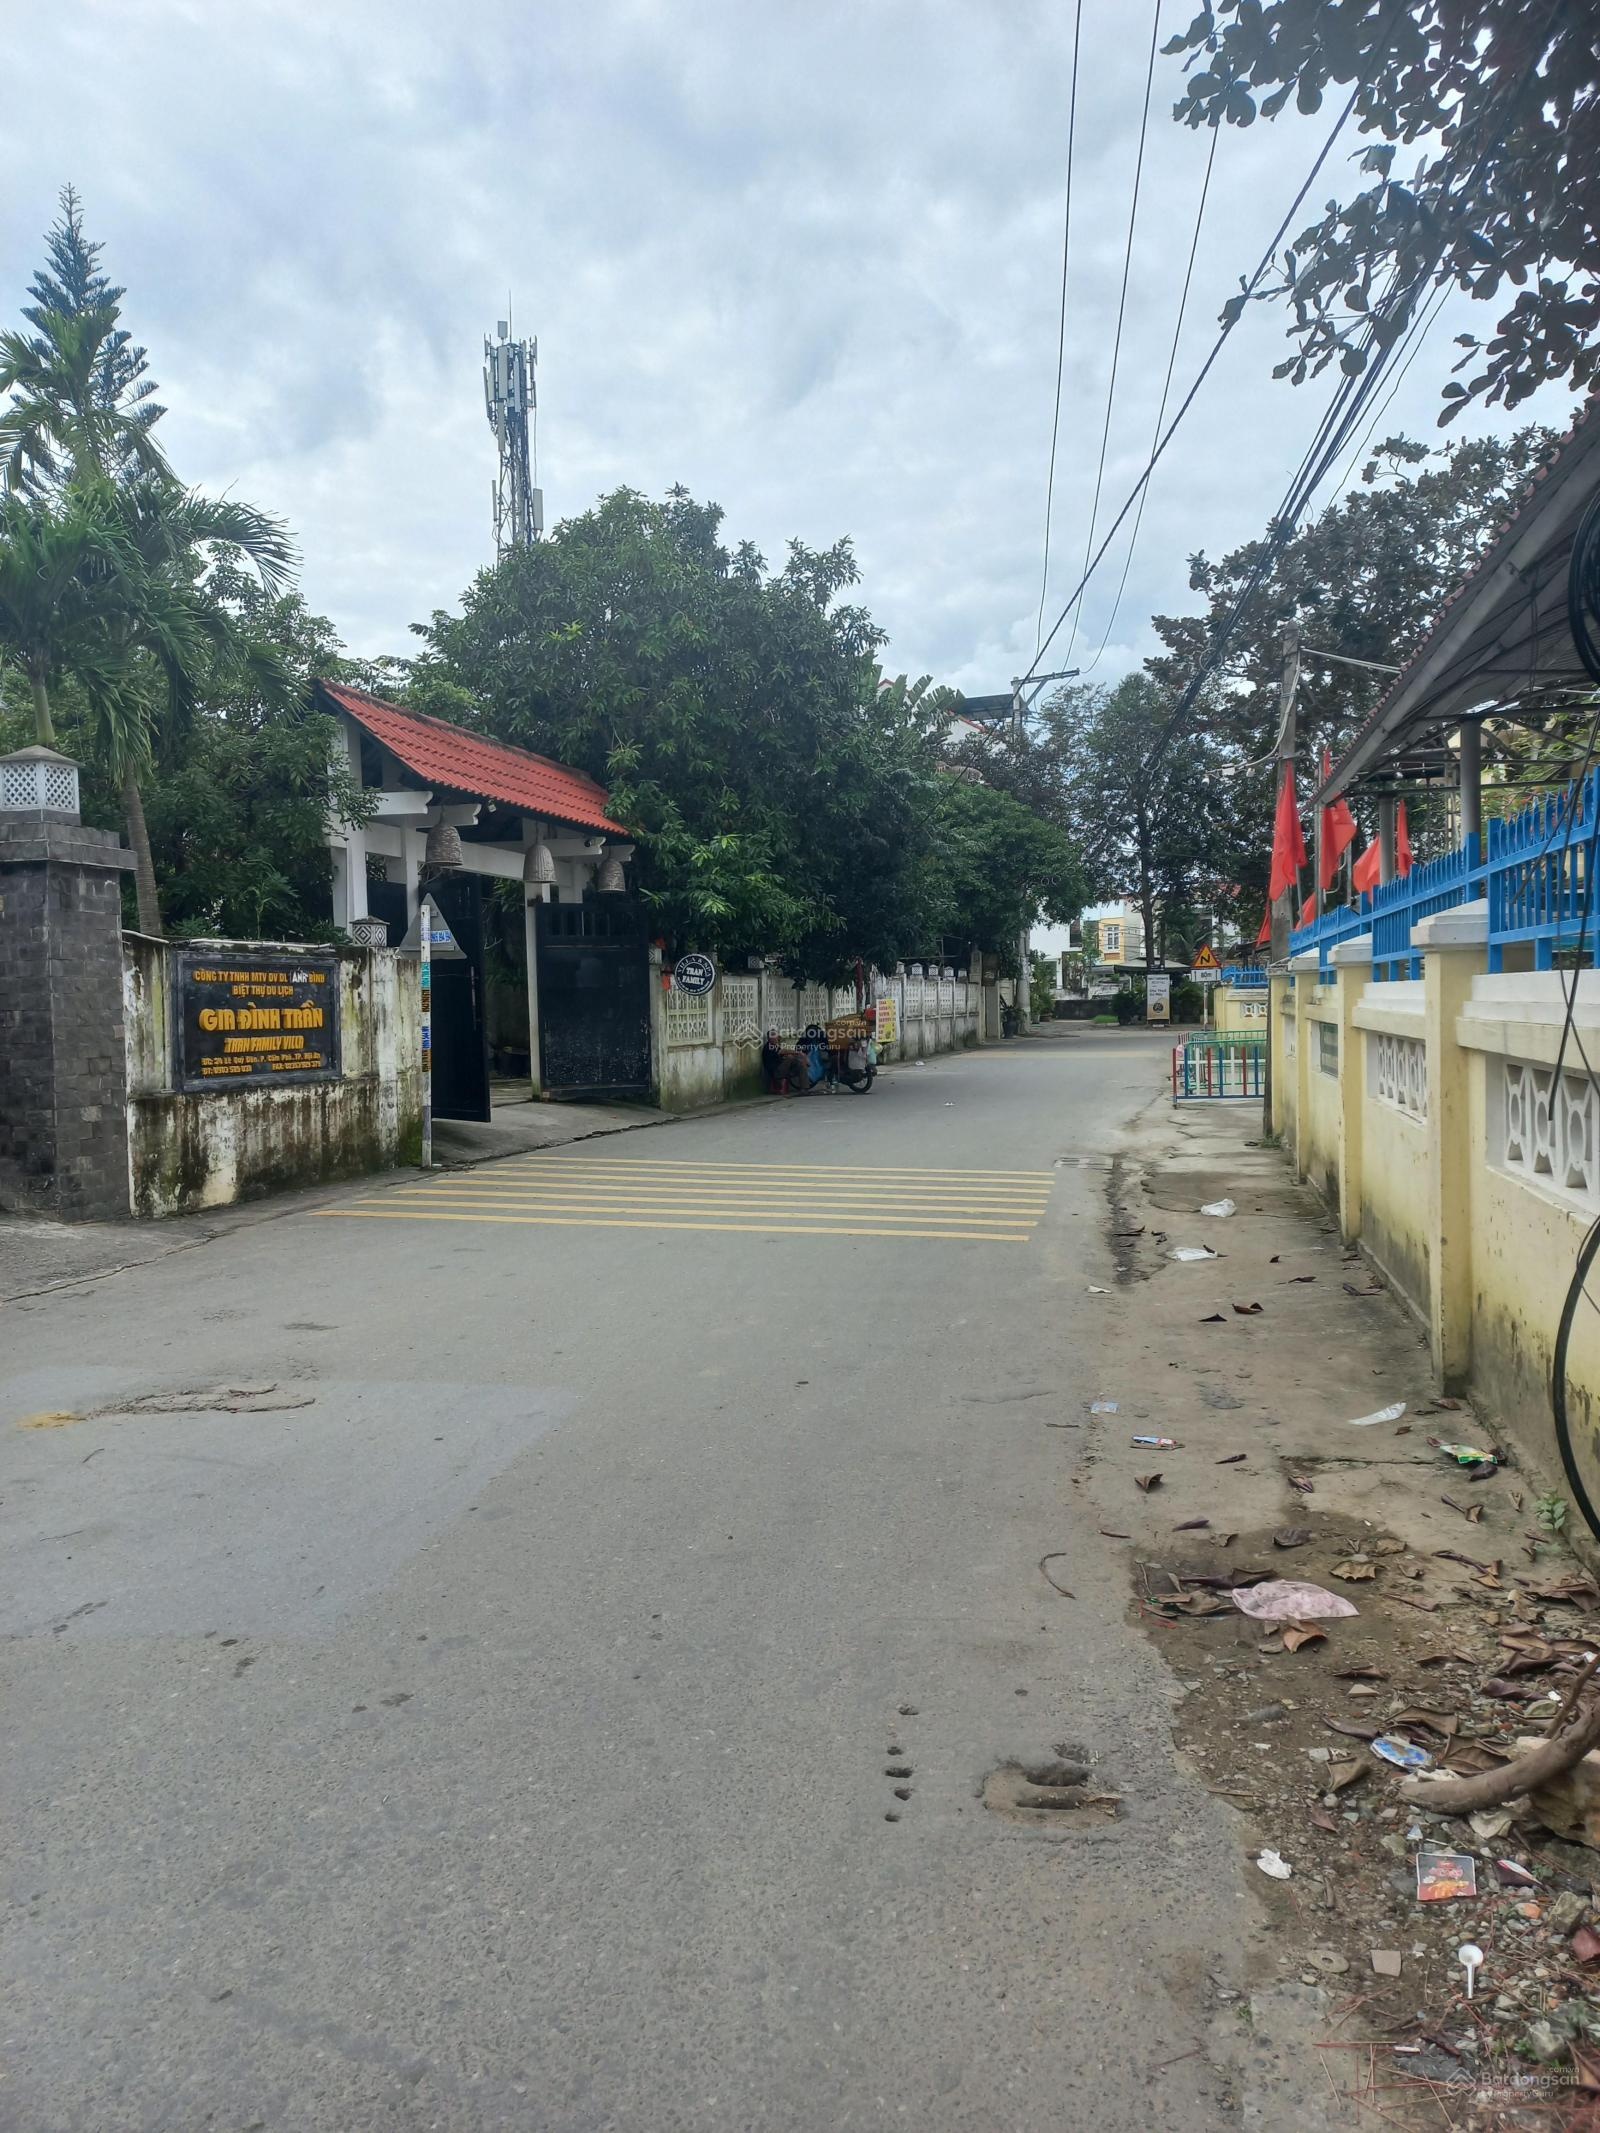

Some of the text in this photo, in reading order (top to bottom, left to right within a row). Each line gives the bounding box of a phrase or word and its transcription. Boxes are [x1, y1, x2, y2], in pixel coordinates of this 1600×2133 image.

[194, 969, 217, 981] CÔNG
[218, 971, 229, 982] TY
[230, 971, 249, 982] TNHH
[251, 971, 267, 982] MTV
[686, 967, 704, 976] TRAN
[682, 975, 705, 985] FAMILY
[266, 986, 277, 995] DU
[199, 1000, 323, 1031] GIA ĐÌNH TRẦN
[224, 1035, 304, 1053] TRAN FAMILY VILLA
